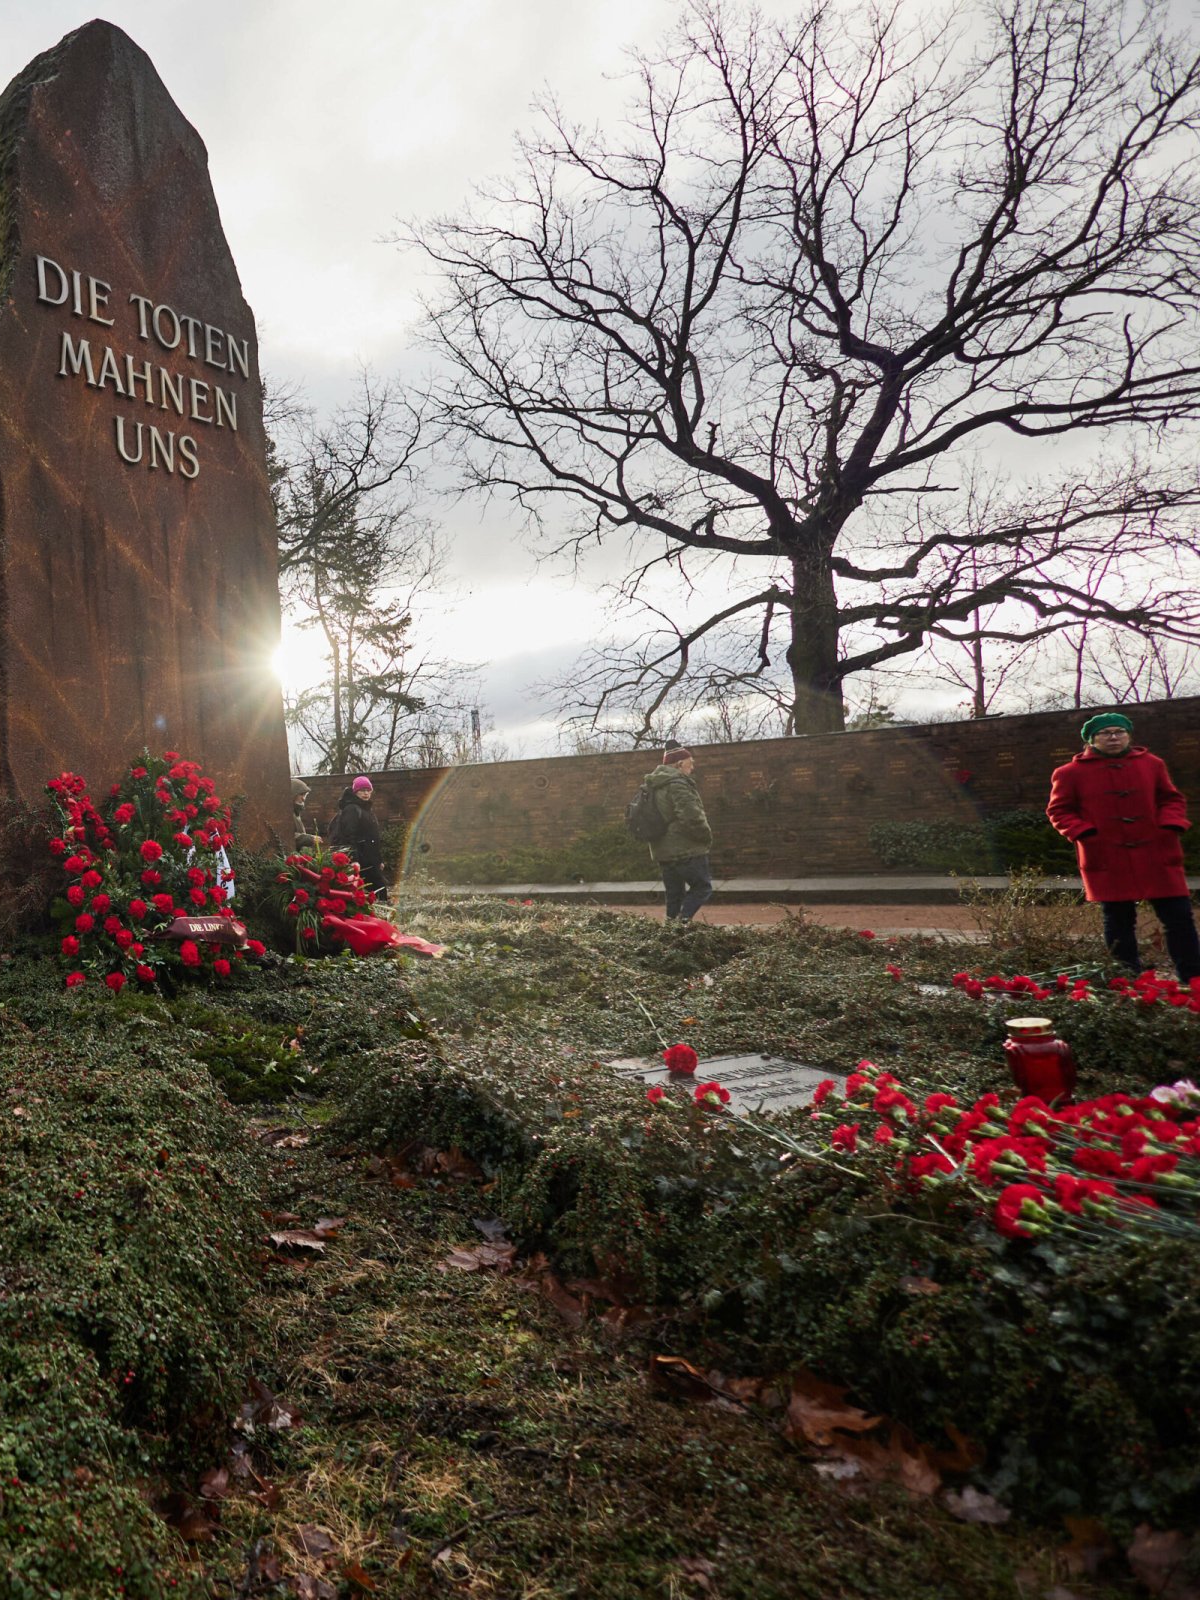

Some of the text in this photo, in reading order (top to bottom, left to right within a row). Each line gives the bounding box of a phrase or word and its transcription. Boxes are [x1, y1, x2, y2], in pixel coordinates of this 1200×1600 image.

[36, 254, 250, 379] DIE TOTEN
[58, 331, 238, 431] MAHNEN
[115, 414, 200, 479] UNS
